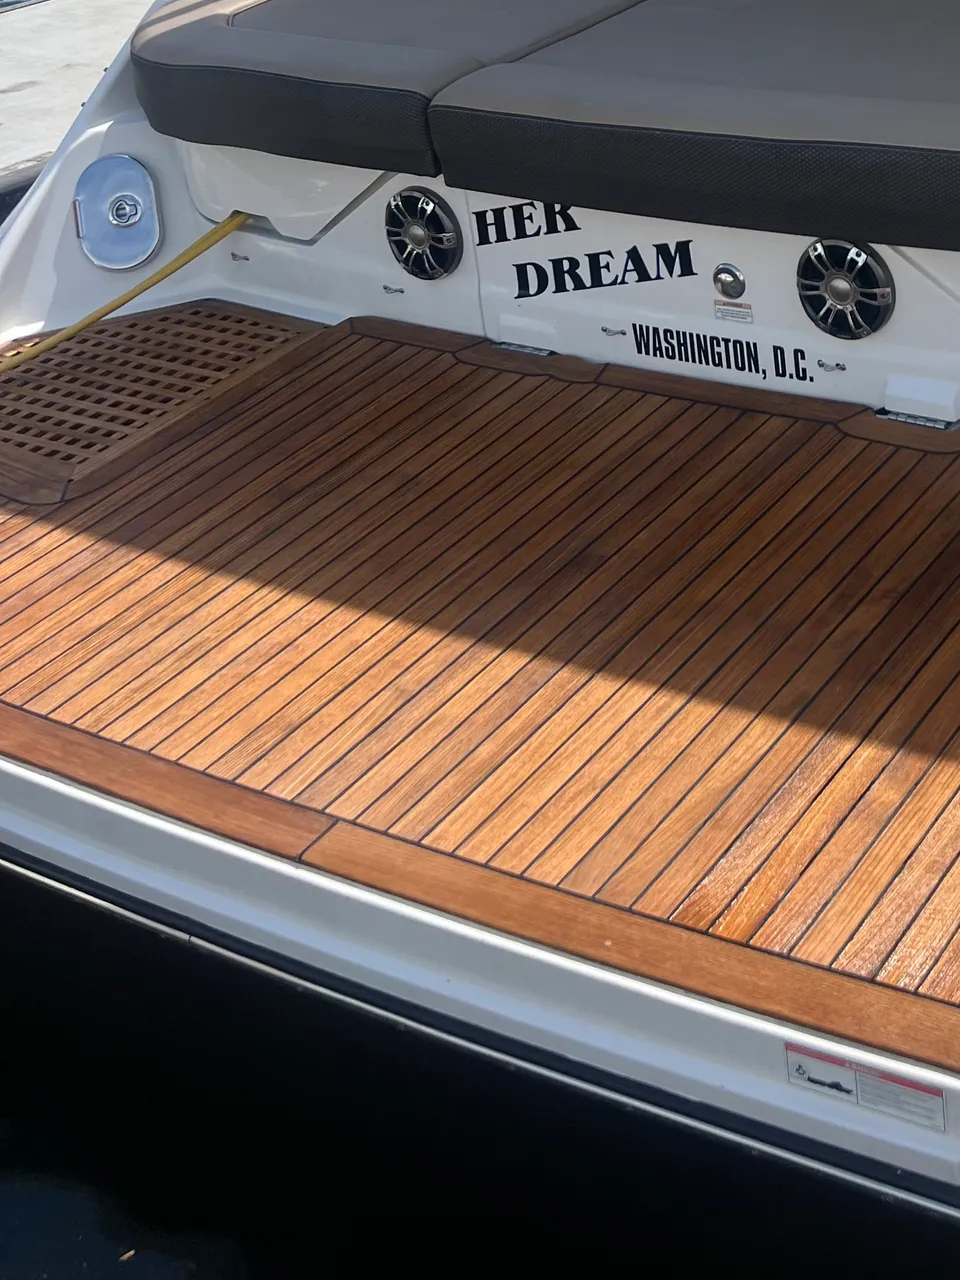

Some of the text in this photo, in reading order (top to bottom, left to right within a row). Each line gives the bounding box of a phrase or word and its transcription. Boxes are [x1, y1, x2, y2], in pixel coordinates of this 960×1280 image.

[472, 201, 582, 246] HER
[512, 239, 698, 299] DREAM
[632, 323, 814, 382] WASHINGTON, D.C.
